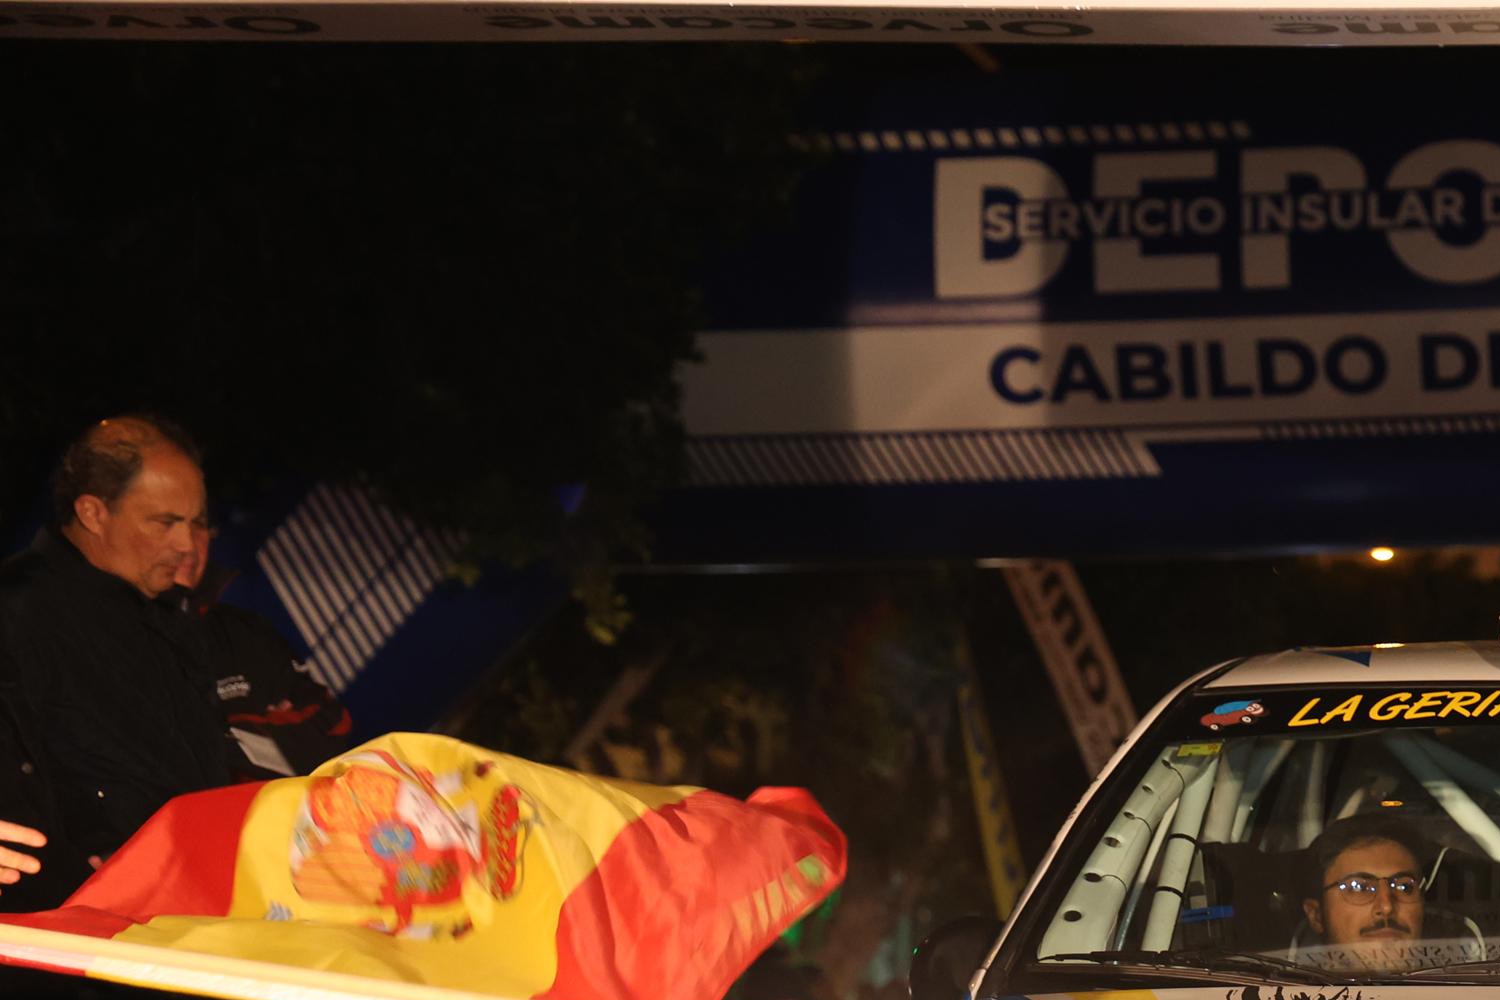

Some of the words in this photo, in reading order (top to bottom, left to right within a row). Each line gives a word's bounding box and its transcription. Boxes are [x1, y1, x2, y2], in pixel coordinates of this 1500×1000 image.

[0, 13, 321, 34] Orve
[485, 15, 1094, 37] Orvecame
[983, 196, 1226, 243] SERVICIO
[1242, 188, 1465, 234] INSULAR
[989, 336, 1388, 404] CABILDO
[1287, 694, 1364, 727] LA
